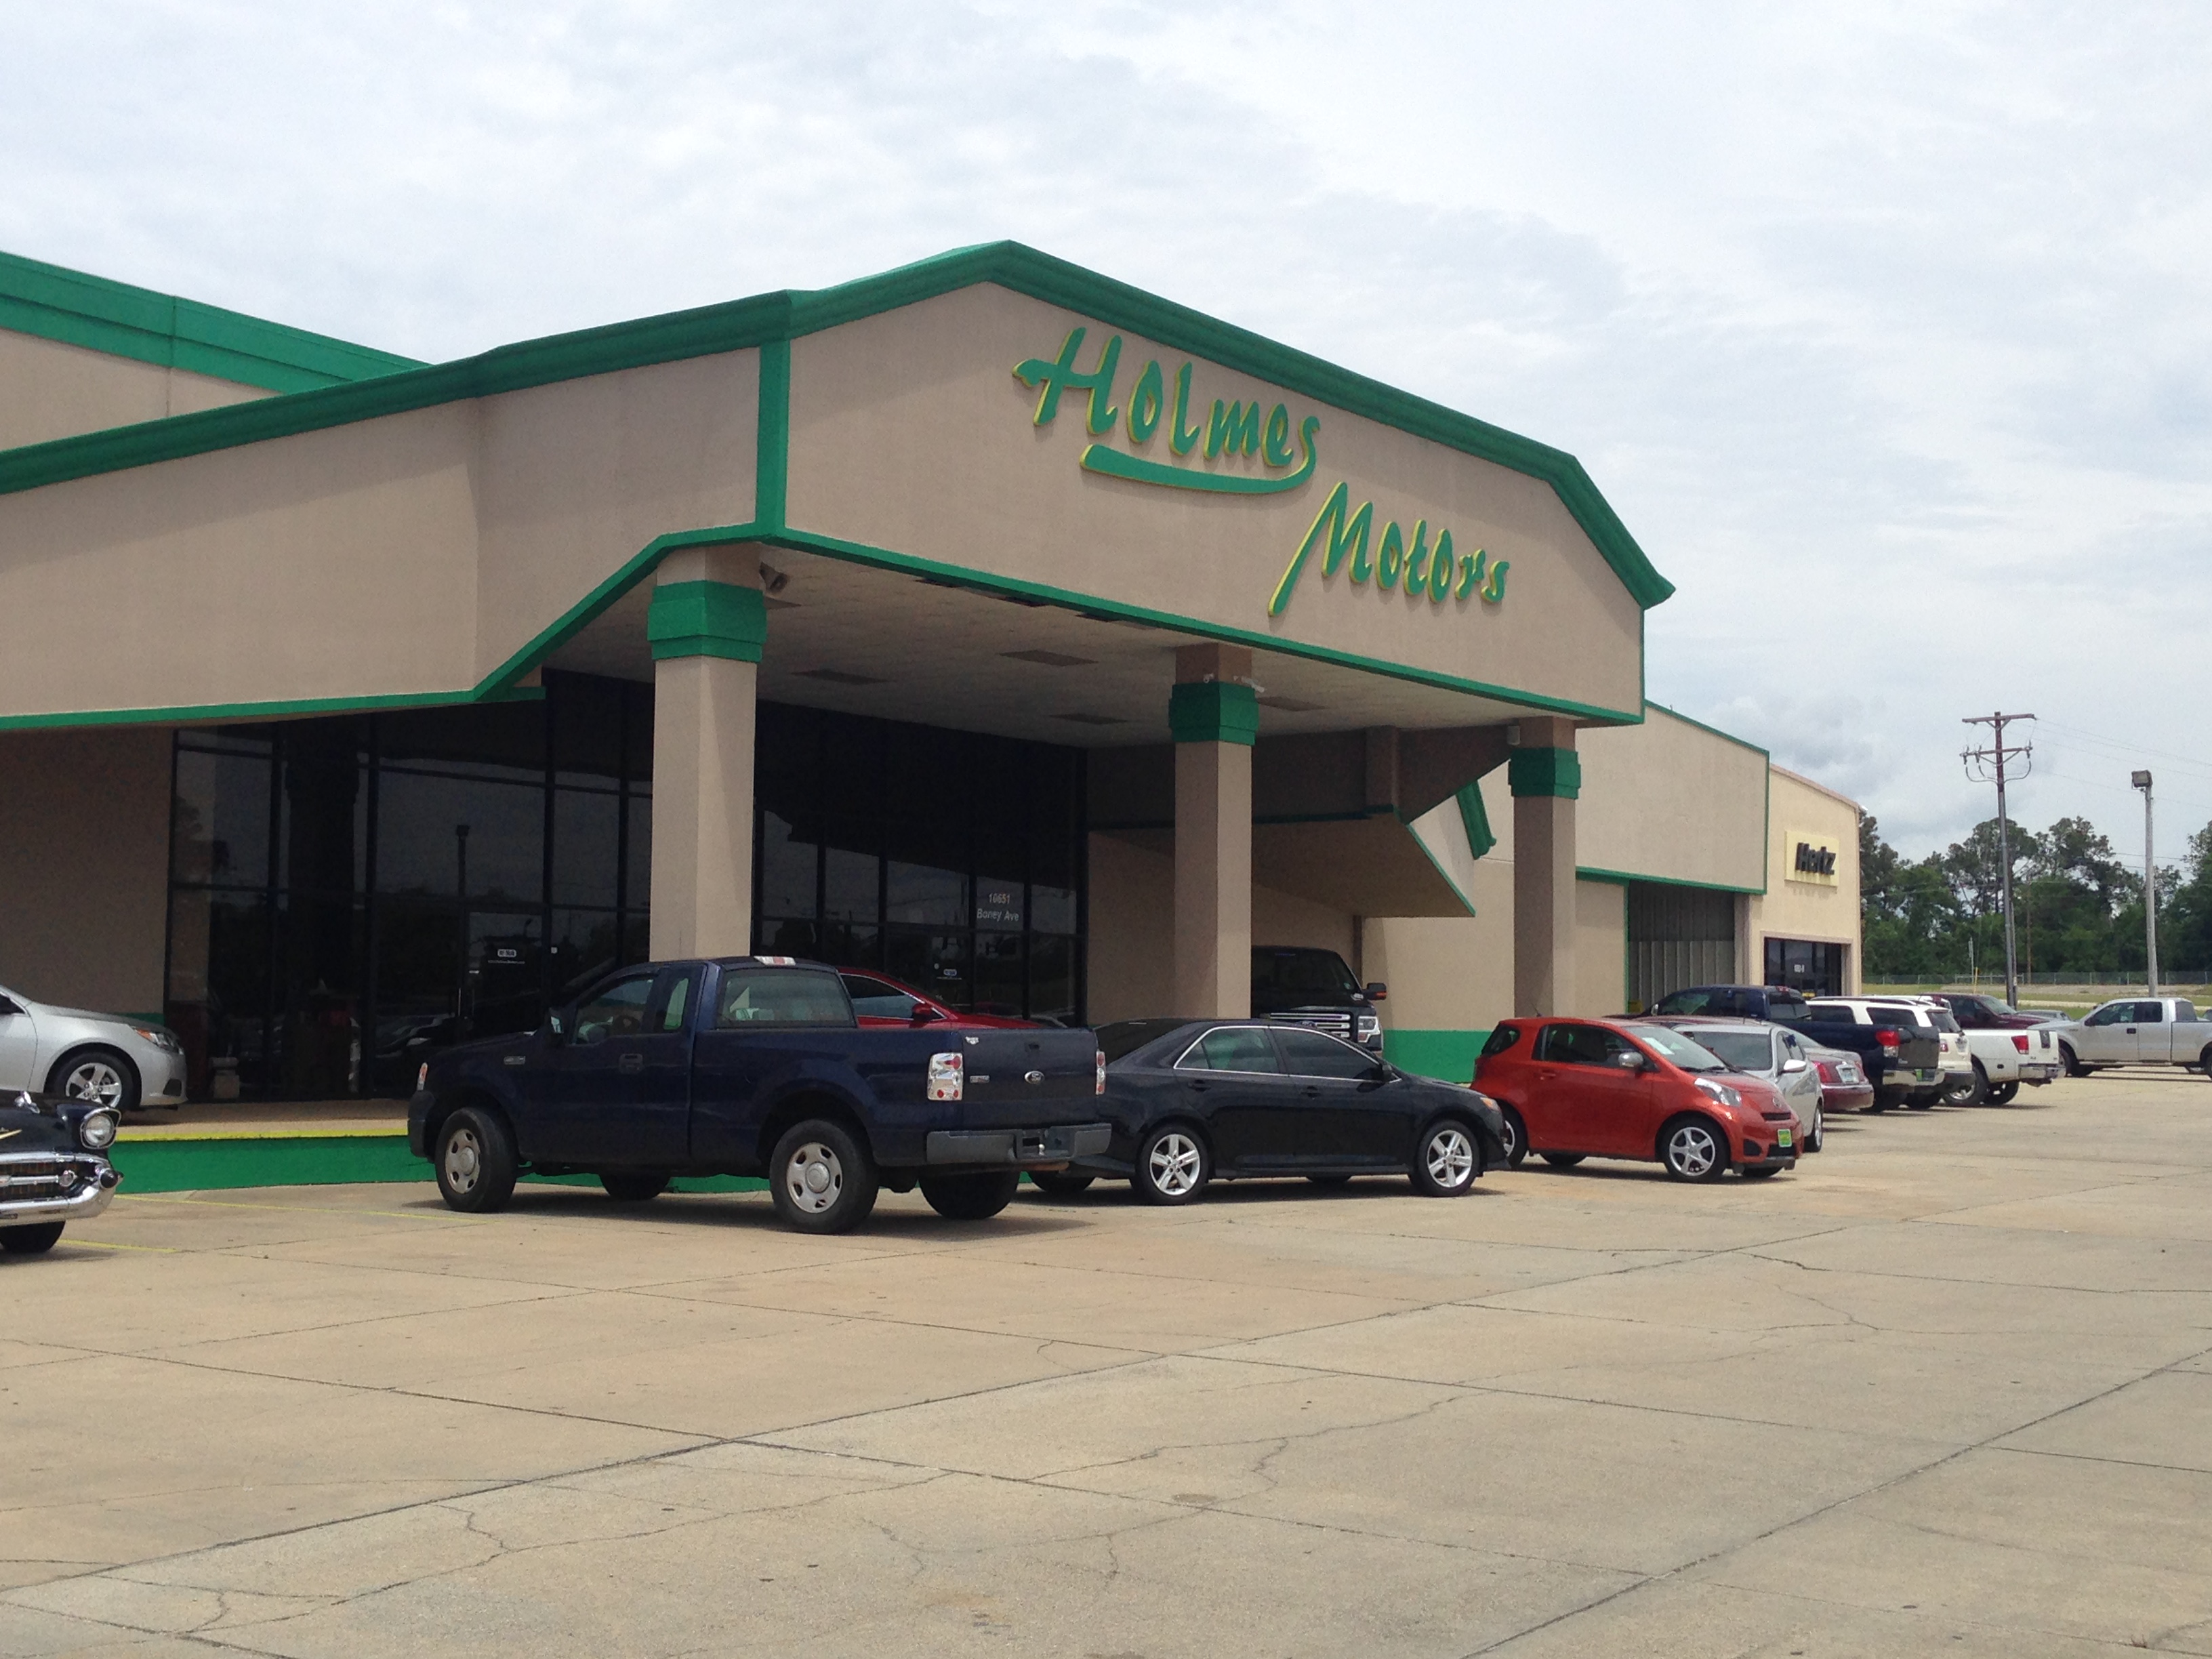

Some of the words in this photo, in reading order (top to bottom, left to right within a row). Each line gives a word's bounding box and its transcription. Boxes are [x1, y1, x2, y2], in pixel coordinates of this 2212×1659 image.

[1269, 480, 1510, 617] Motors
[1795, 842, 1836, 876] Hertz
[977, 908, 1002, 922] Boney
[1004, 910, 1019, 922] Ave
